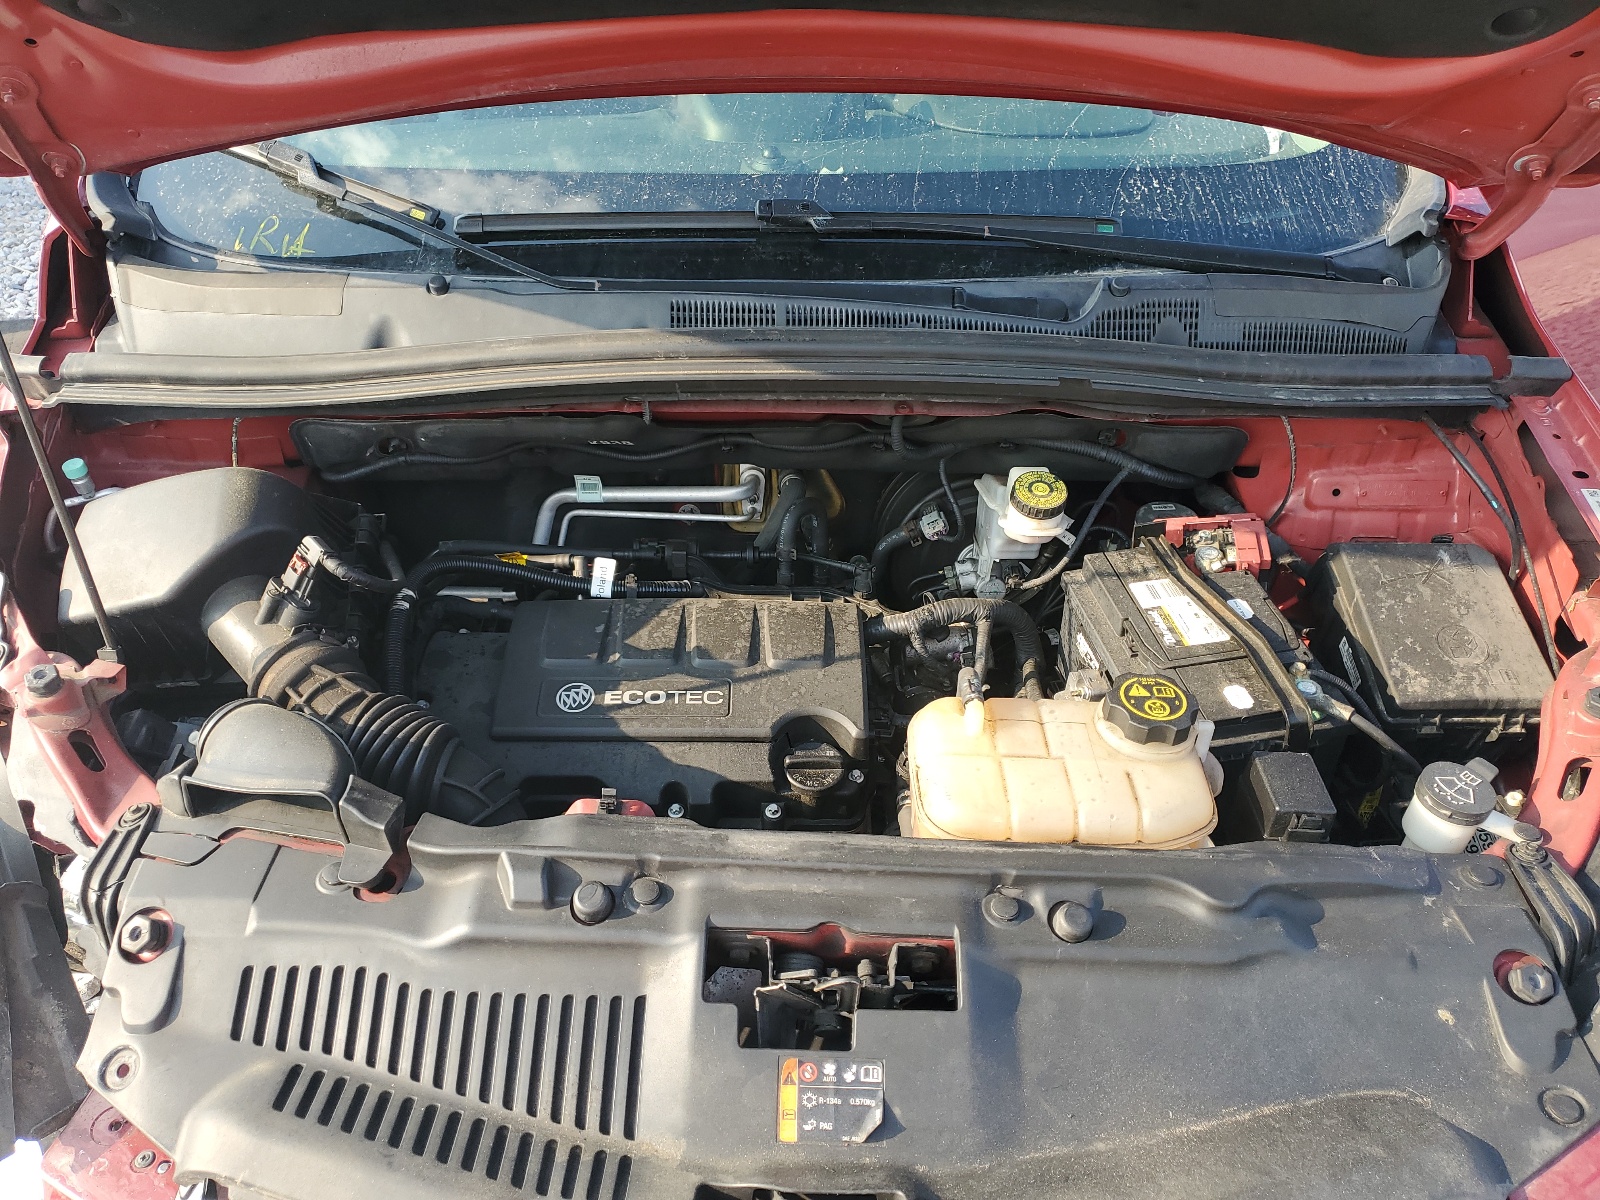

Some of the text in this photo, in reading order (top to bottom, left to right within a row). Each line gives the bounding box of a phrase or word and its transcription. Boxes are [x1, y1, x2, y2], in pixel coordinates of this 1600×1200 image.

[603, 690, 724, 705] ECOTEC
[822, 1075, 837, 1083] AUTO
[818, 1096, 842, 1105] R-134a
[819, 1121, 833, 1131] PAG
